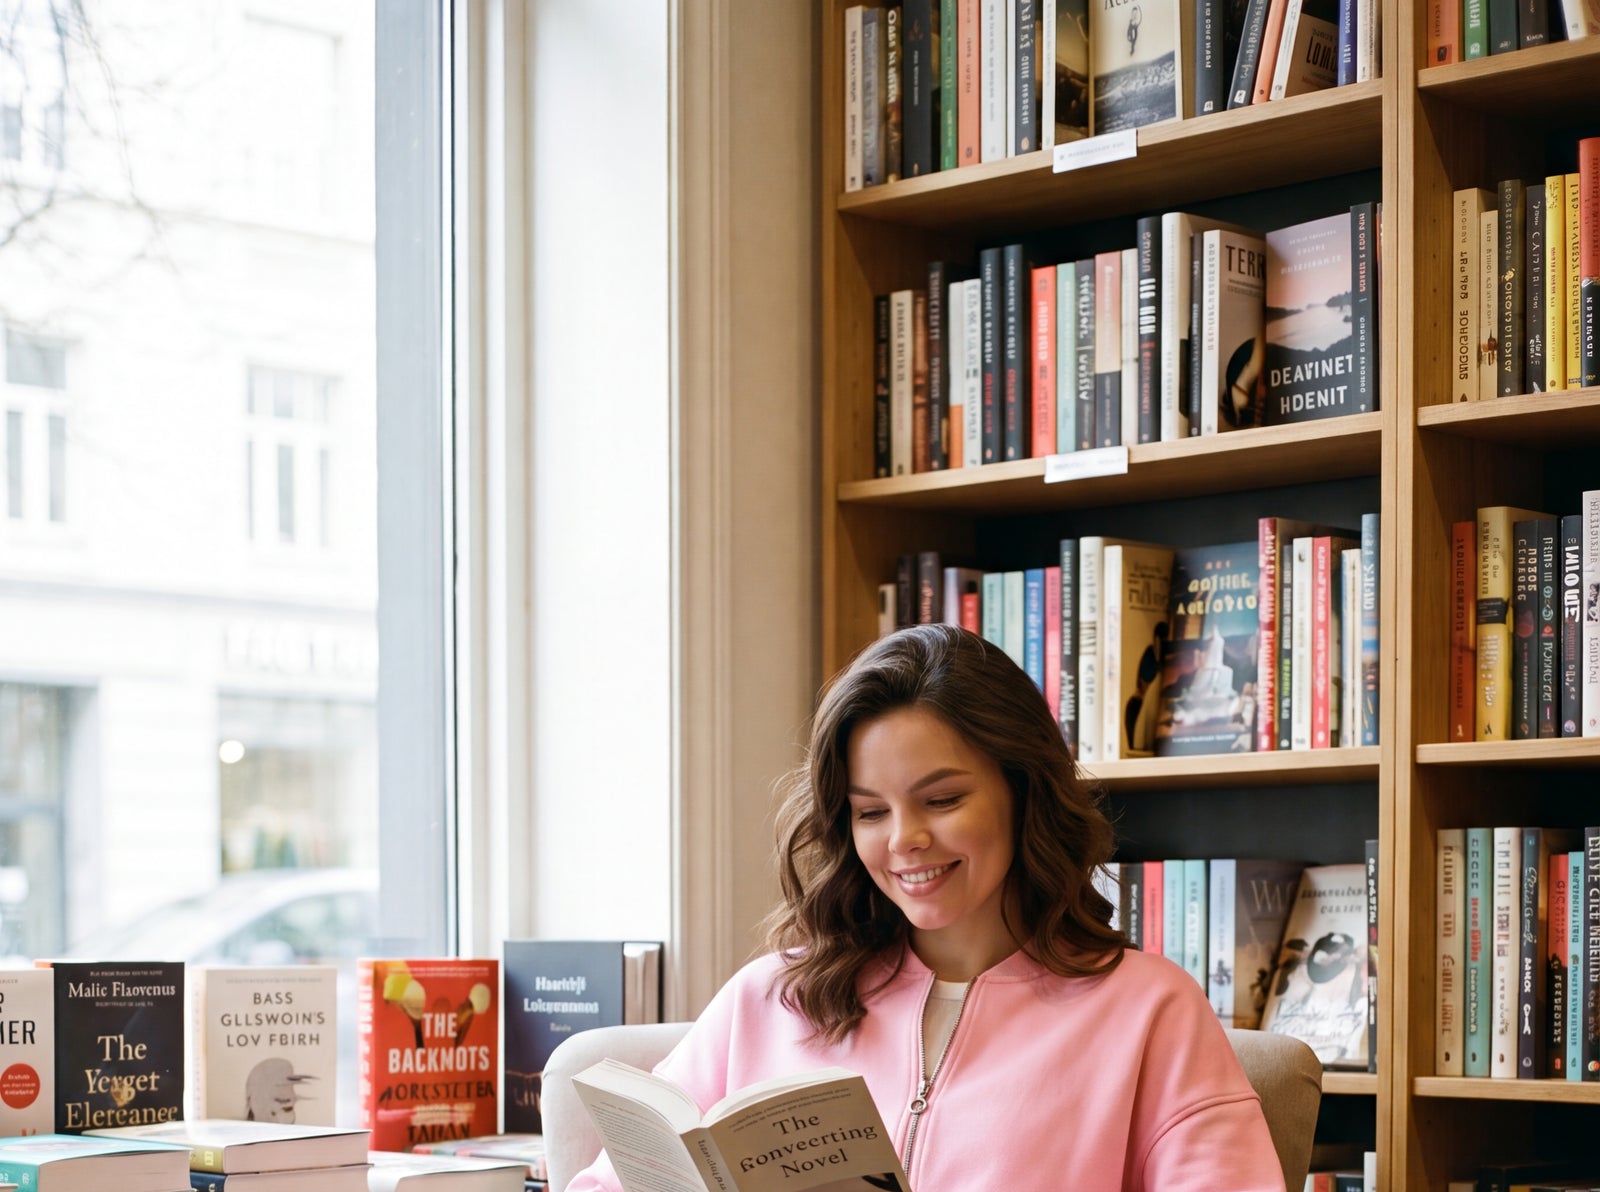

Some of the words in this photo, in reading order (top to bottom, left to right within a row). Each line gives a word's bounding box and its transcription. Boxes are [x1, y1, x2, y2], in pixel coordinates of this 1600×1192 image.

[253, 992, 294, 1005] BASS
[0, 1020, 36, 1045] ER
[423, 1013, 458, 1038] THE
[97, 1034, 147, 1062] The
[227, 1034, 261, 1047] LOV
[388, 1046, 490, 1074] BACKNOTS
[772, 1115, 820, 1135] The
[780, 1148, 849, 1178] Novel
